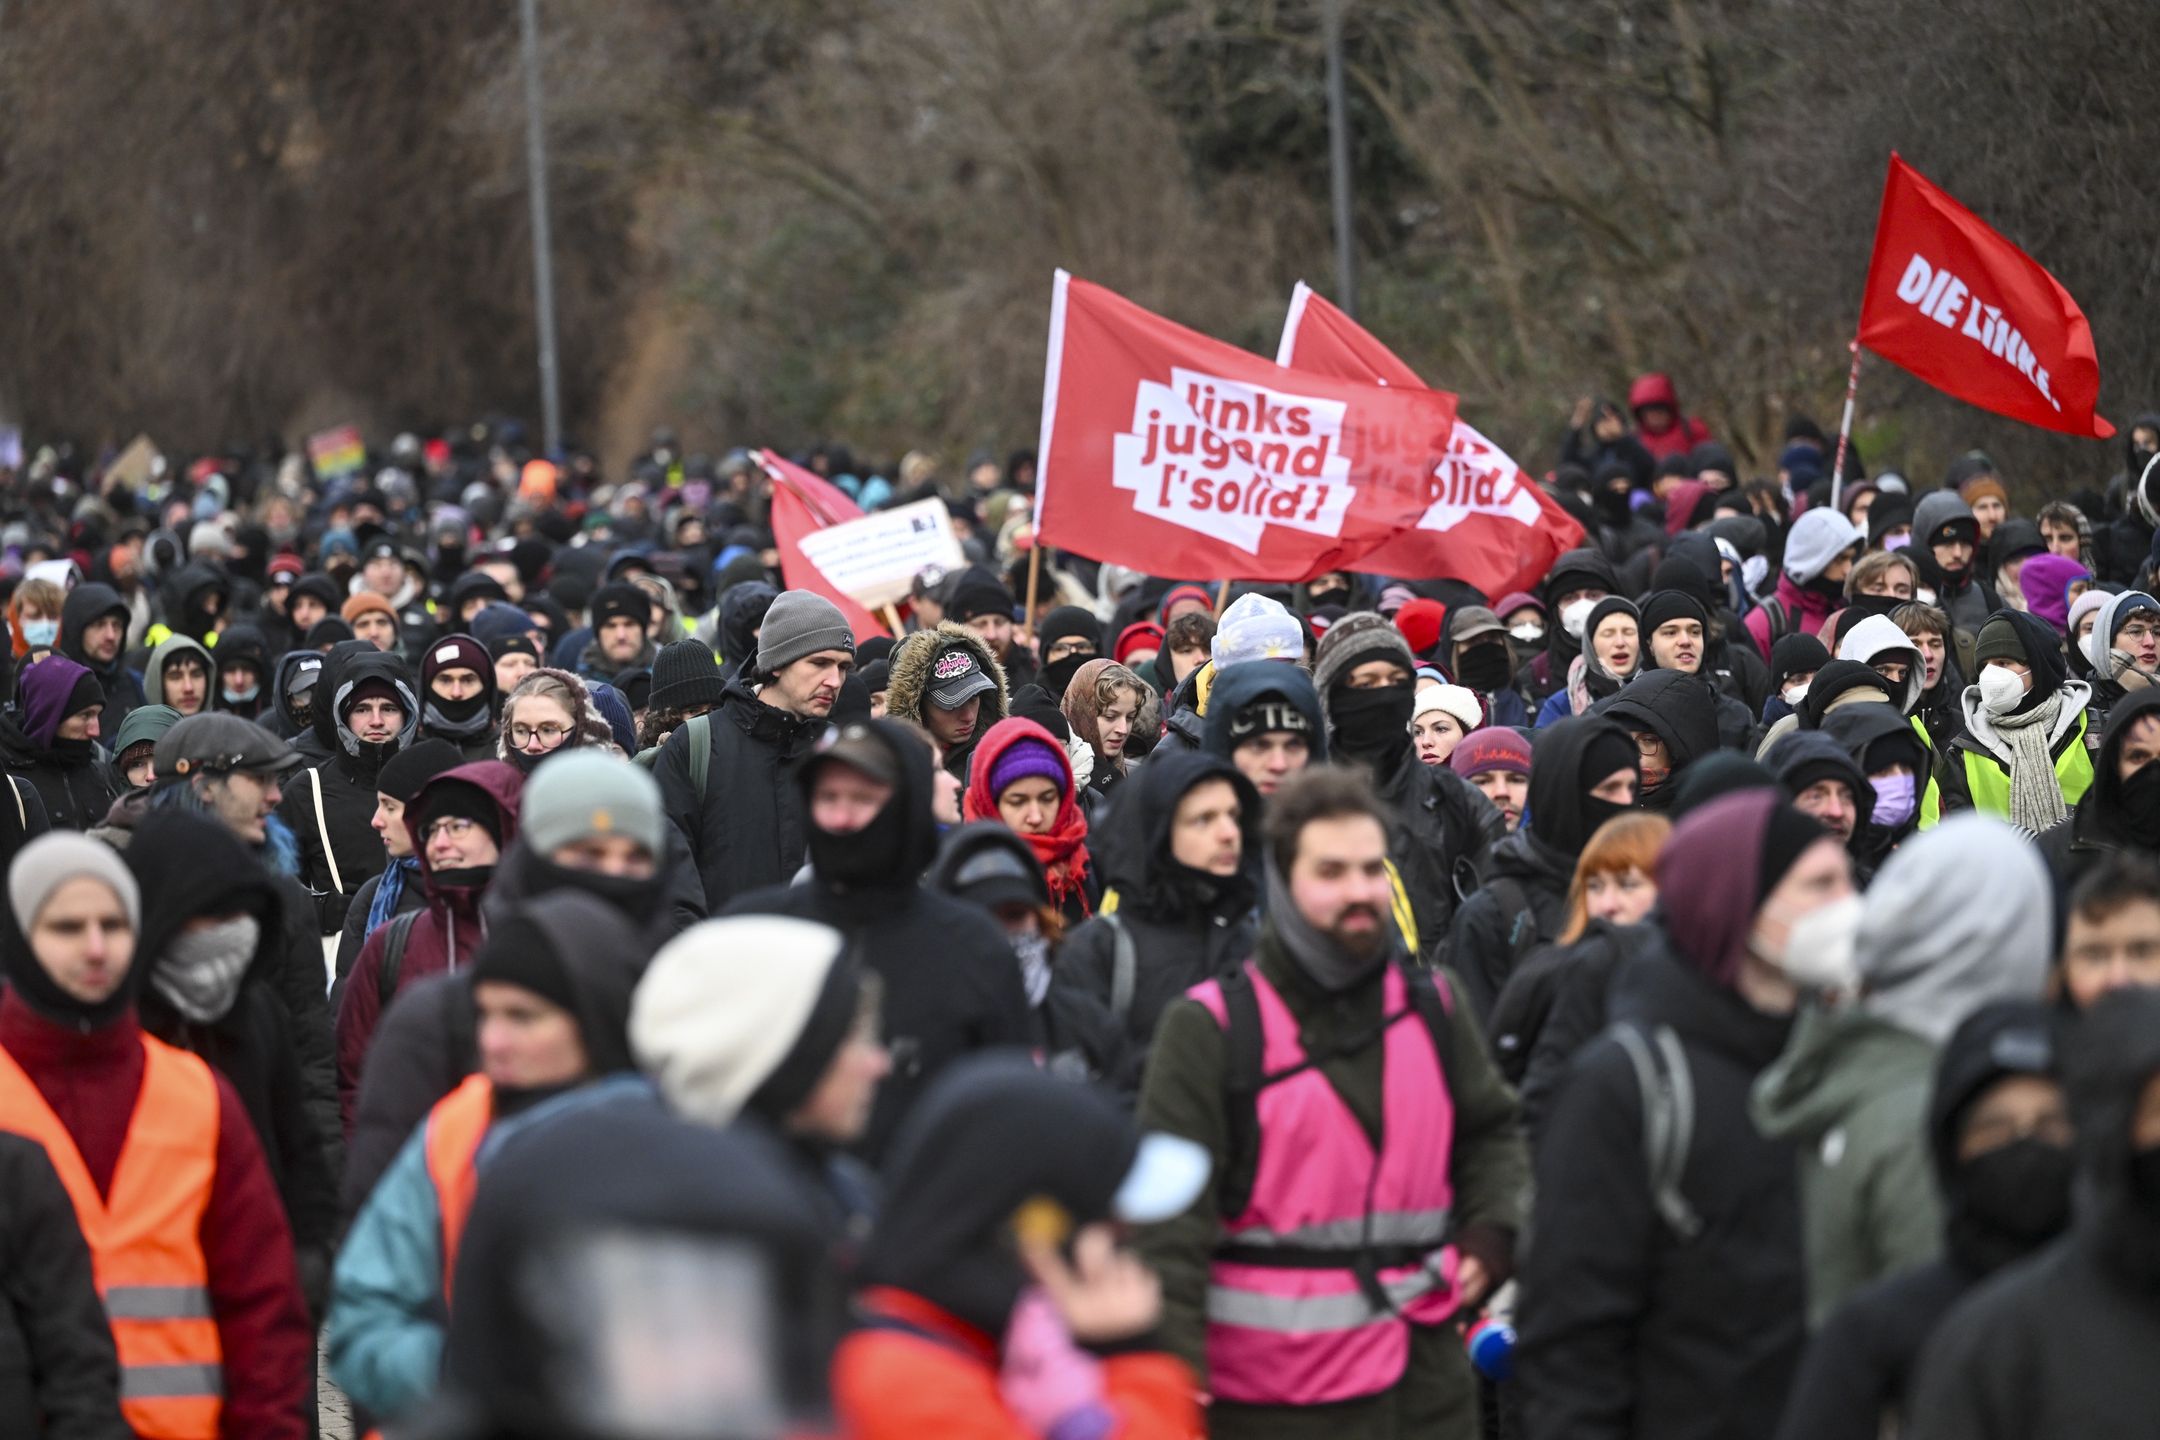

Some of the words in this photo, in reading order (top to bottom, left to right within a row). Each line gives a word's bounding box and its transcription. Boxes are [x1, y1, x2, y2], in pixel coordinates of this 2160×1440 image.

[1896, 252, 1969, 329] DIE
[1140, 409, 1331, 478] jugend
[1187, 382, 1312, 437] links
